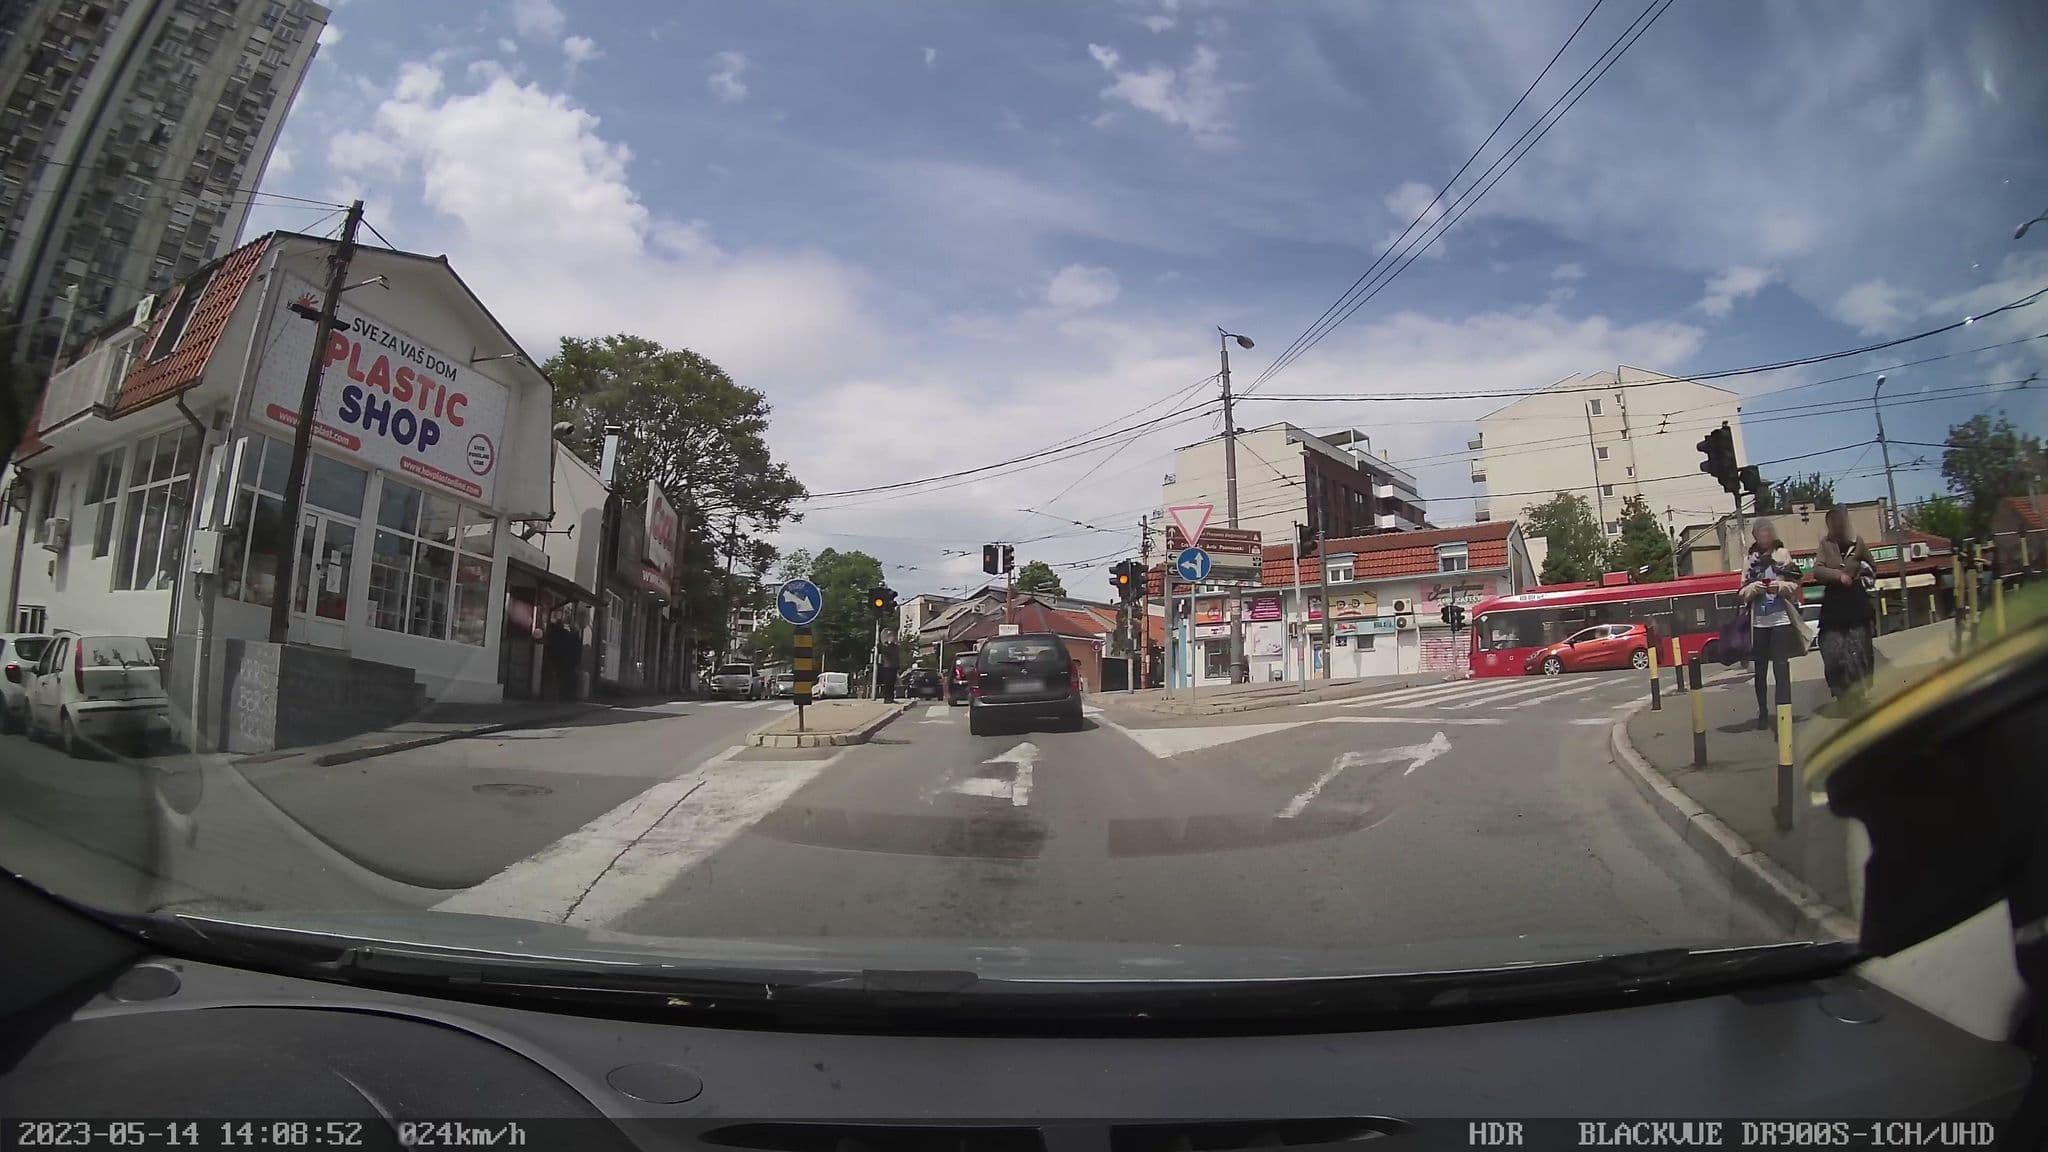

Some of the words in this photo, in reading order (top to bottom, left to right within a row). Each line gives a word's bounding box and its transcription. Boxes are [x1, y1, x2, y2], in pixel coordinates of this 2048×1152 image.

[324, 329, 468, 427] PLASTIC
[352, 317, 380, 342] SVE
[379, 330, 398, 352] ZA
[400, 340, 425, 364] VAŠ
[425, 355, 457, 381] DOM
[338, 384, 441, 453] SHOP
